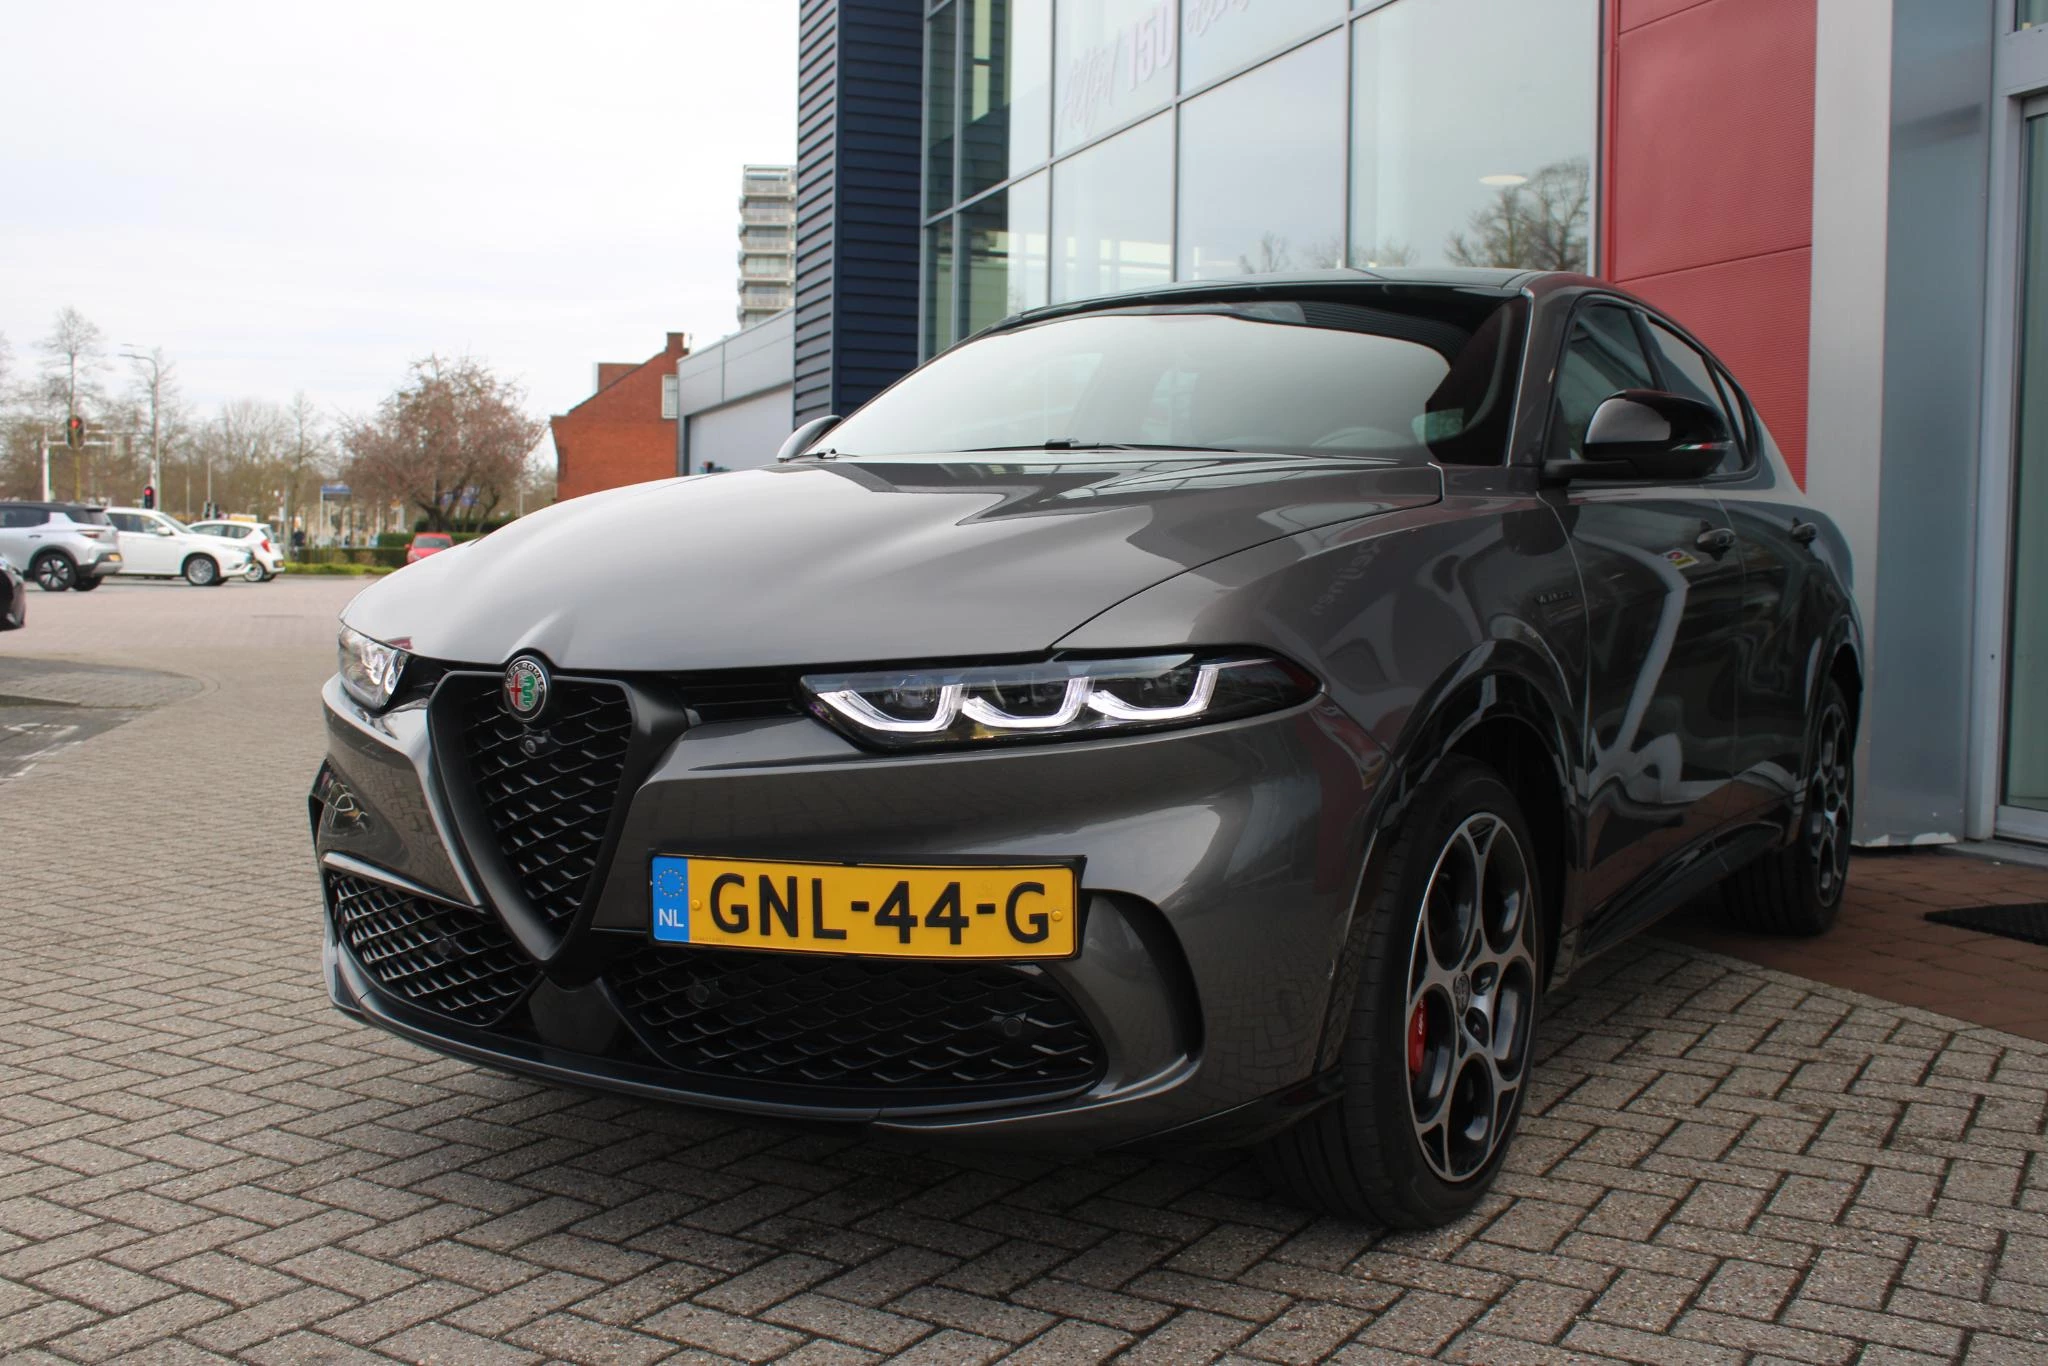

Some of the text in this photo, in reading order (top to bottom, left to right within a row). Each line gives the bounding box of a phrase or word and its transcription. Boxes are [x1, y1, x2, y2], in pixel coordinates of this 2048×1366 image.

[522, 662, 545, 692] ROMEO
[658, 908, 685, 928] NL
[709, 872, 1050, 945] GNL-44-G
